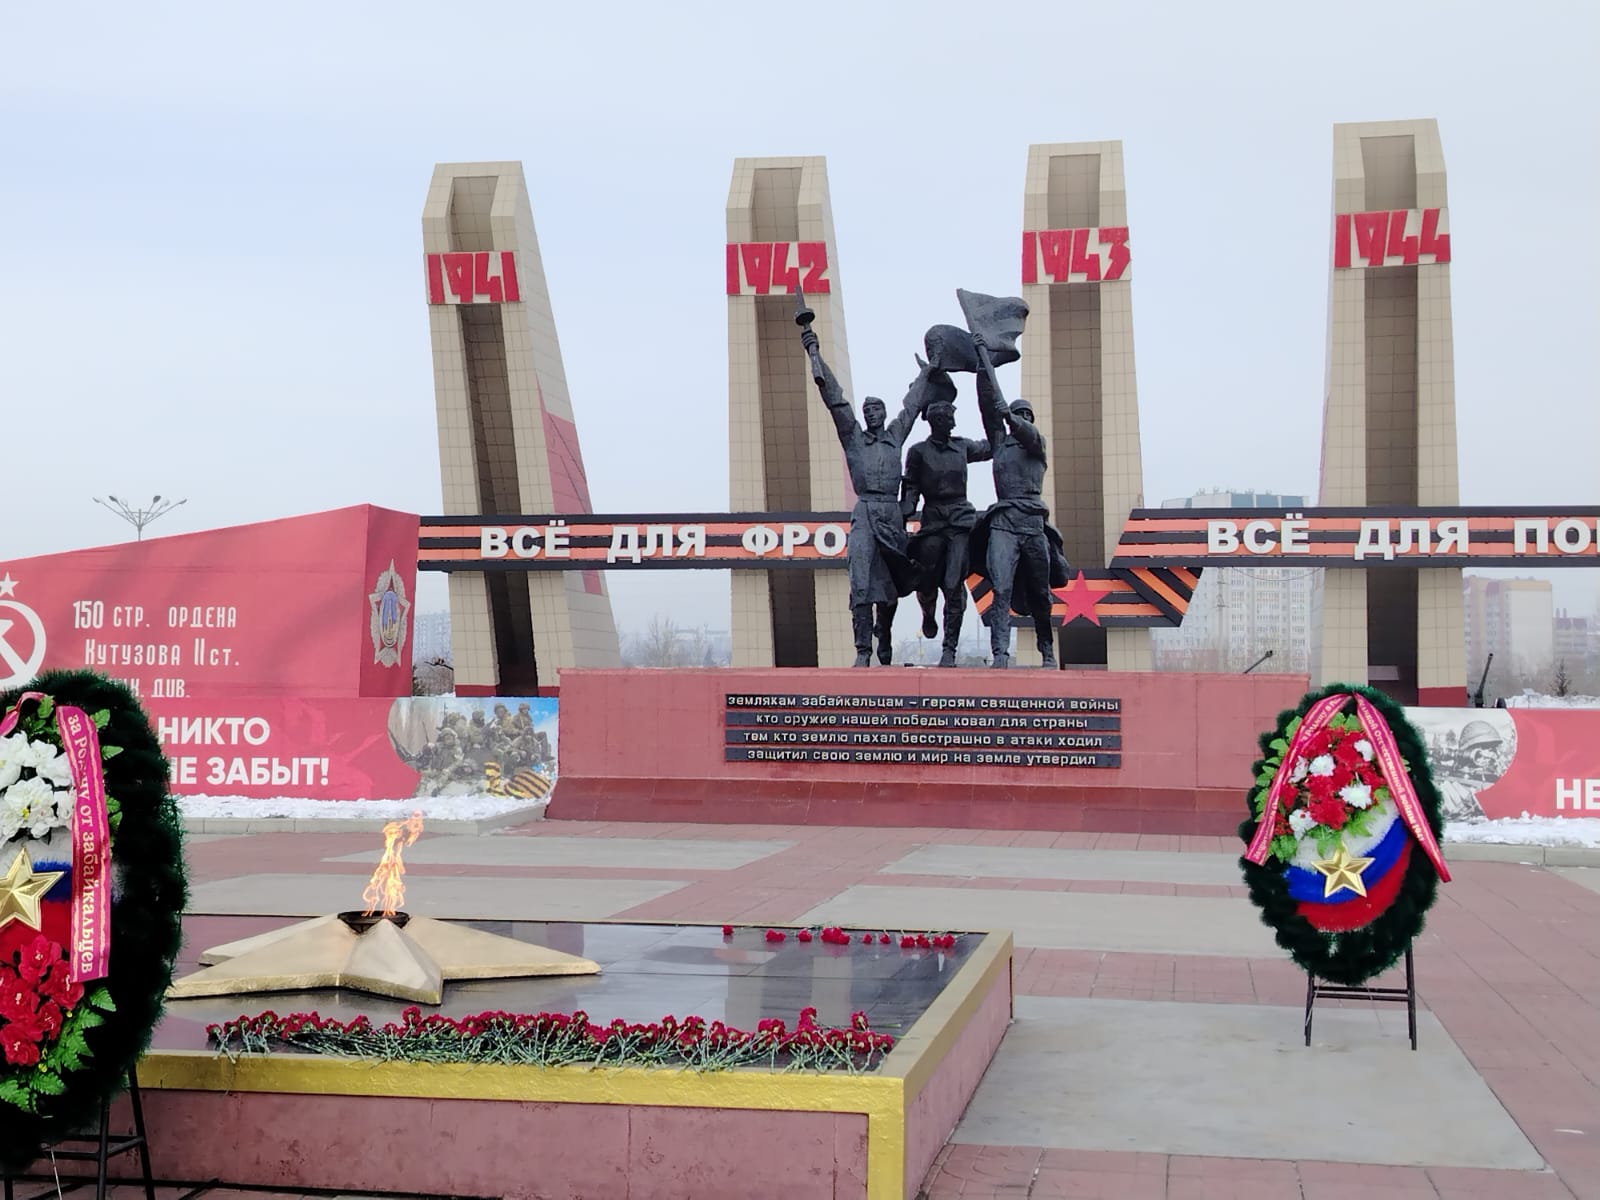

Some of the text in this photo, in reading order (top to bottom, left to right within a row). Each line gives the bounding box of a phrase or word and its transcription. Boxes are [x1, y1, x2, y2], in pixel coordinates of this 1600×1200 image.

[1334, 208, 1450, 268] 1944
[726, 241, 830, 295] 1942
[1022, 226, 1131, 284] 1943
[427, 251, 520, 304] 1941
[480, 520, 848, 564] ВСЁ ДЛЯ ФРО
[1206, 513, 1600, 561] ВСЁ ДЛЯ ПО
[73, 600, 104, 629] 150
[728, 696, 796, 707] землякам
[801, 695, 904, 708] забайкальцам
[922, 698, 975, 709] героям
[980, 698, 1065, 710] священной
[1070, 698, 1119, 711] войны
[67, 714, 82, 736] за
[157, 717, 270, 746] НИКТО
[756, 714, 1088, 730] кто оружие нашей победы ковал для страны
[744, 731, 1102, 747] тем кто землю пахал бесстрашно в атаки ходил
[206, 757, 329, 786] ЗАБЫТ!
[747, 750, 1096, 766] защитил свою землю и мир на земле утвердил
[80, 805, 93, 827] от
[80, 831, 99, 974] забайкальцев
